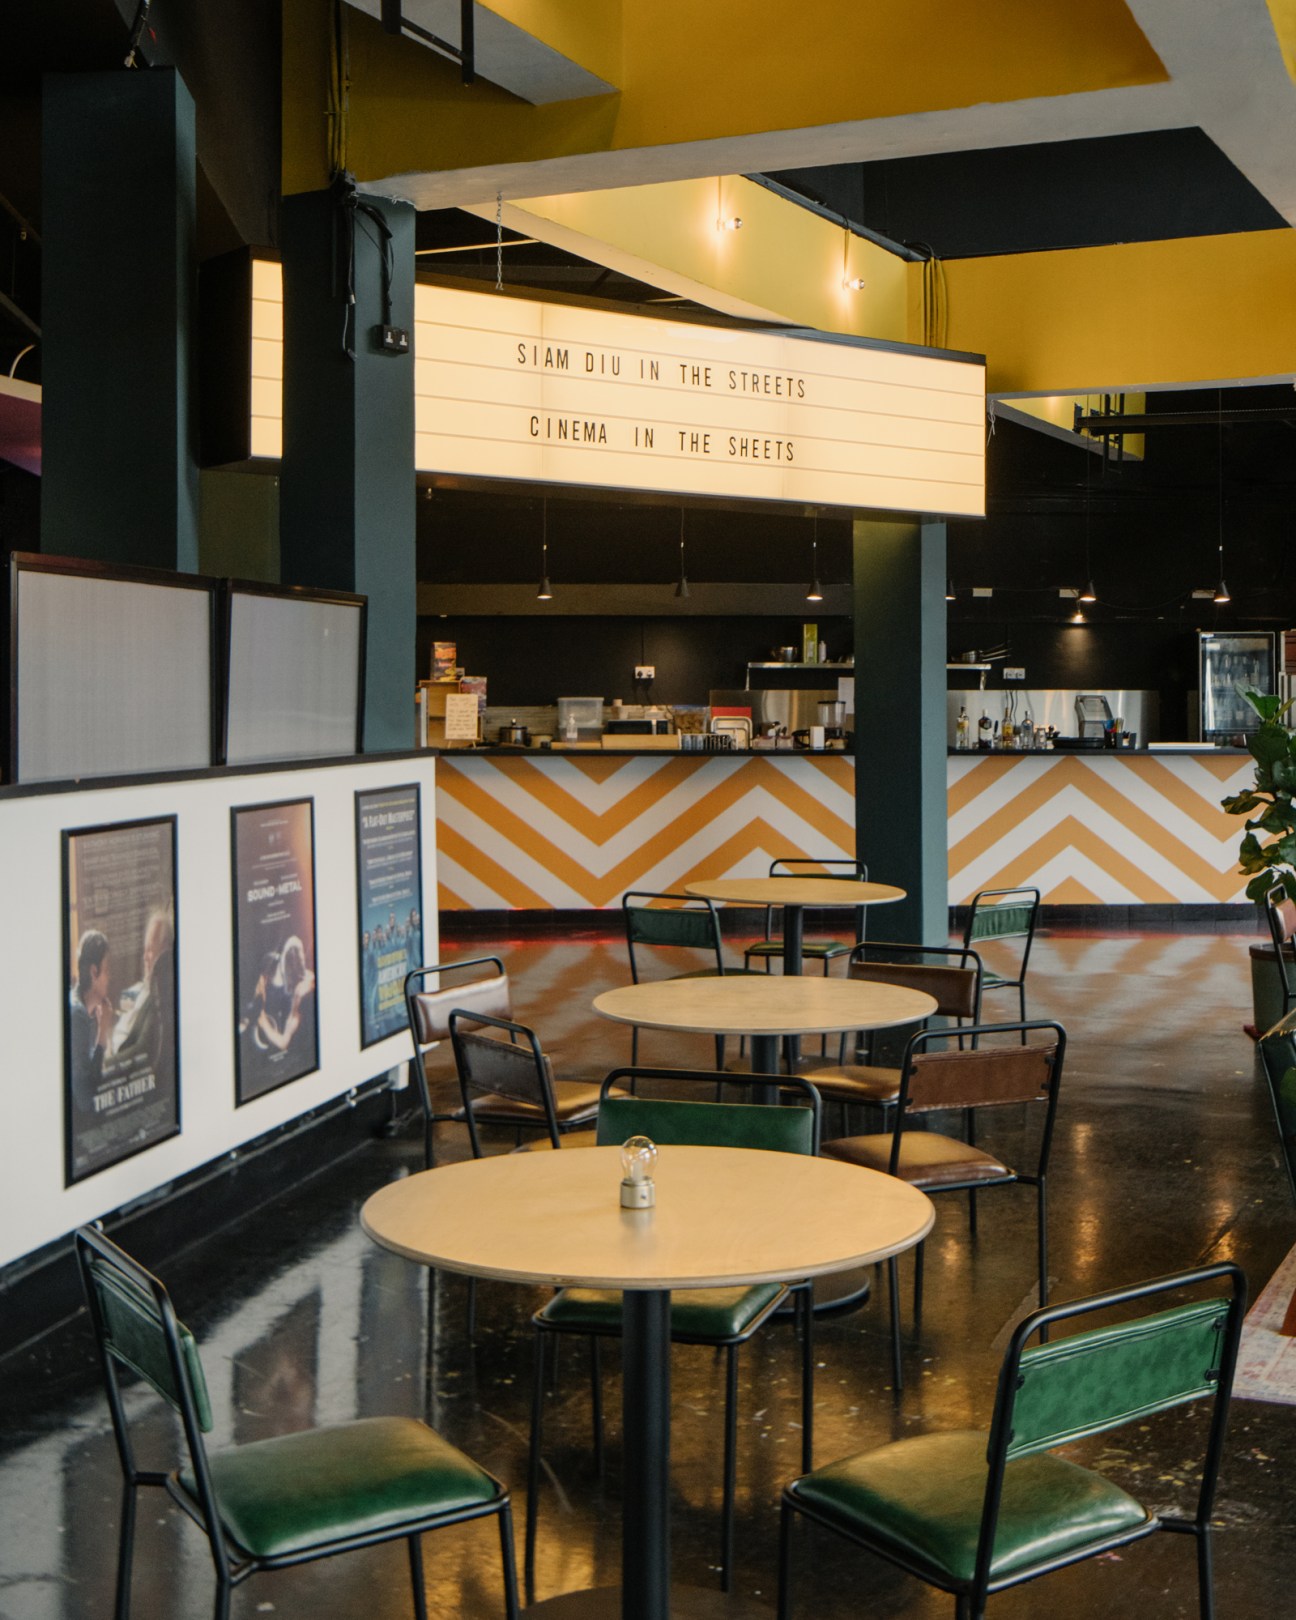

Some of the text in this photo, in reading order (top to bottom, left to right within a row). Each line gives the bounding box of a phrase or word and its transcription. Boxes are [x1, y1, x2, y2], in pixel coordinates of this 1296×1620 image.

[517, 342, 805, 399] SIAM DIU IN THE STREETS
[530, 415, 794, 462] CINEMA IN THE SHEETS
[247, 885, 275, 903] SOUND
[279, 880, 302, 896] METAL
[94, 1089, 115, 1113] THE
[118, 1074, 156, 1102] FATHER
